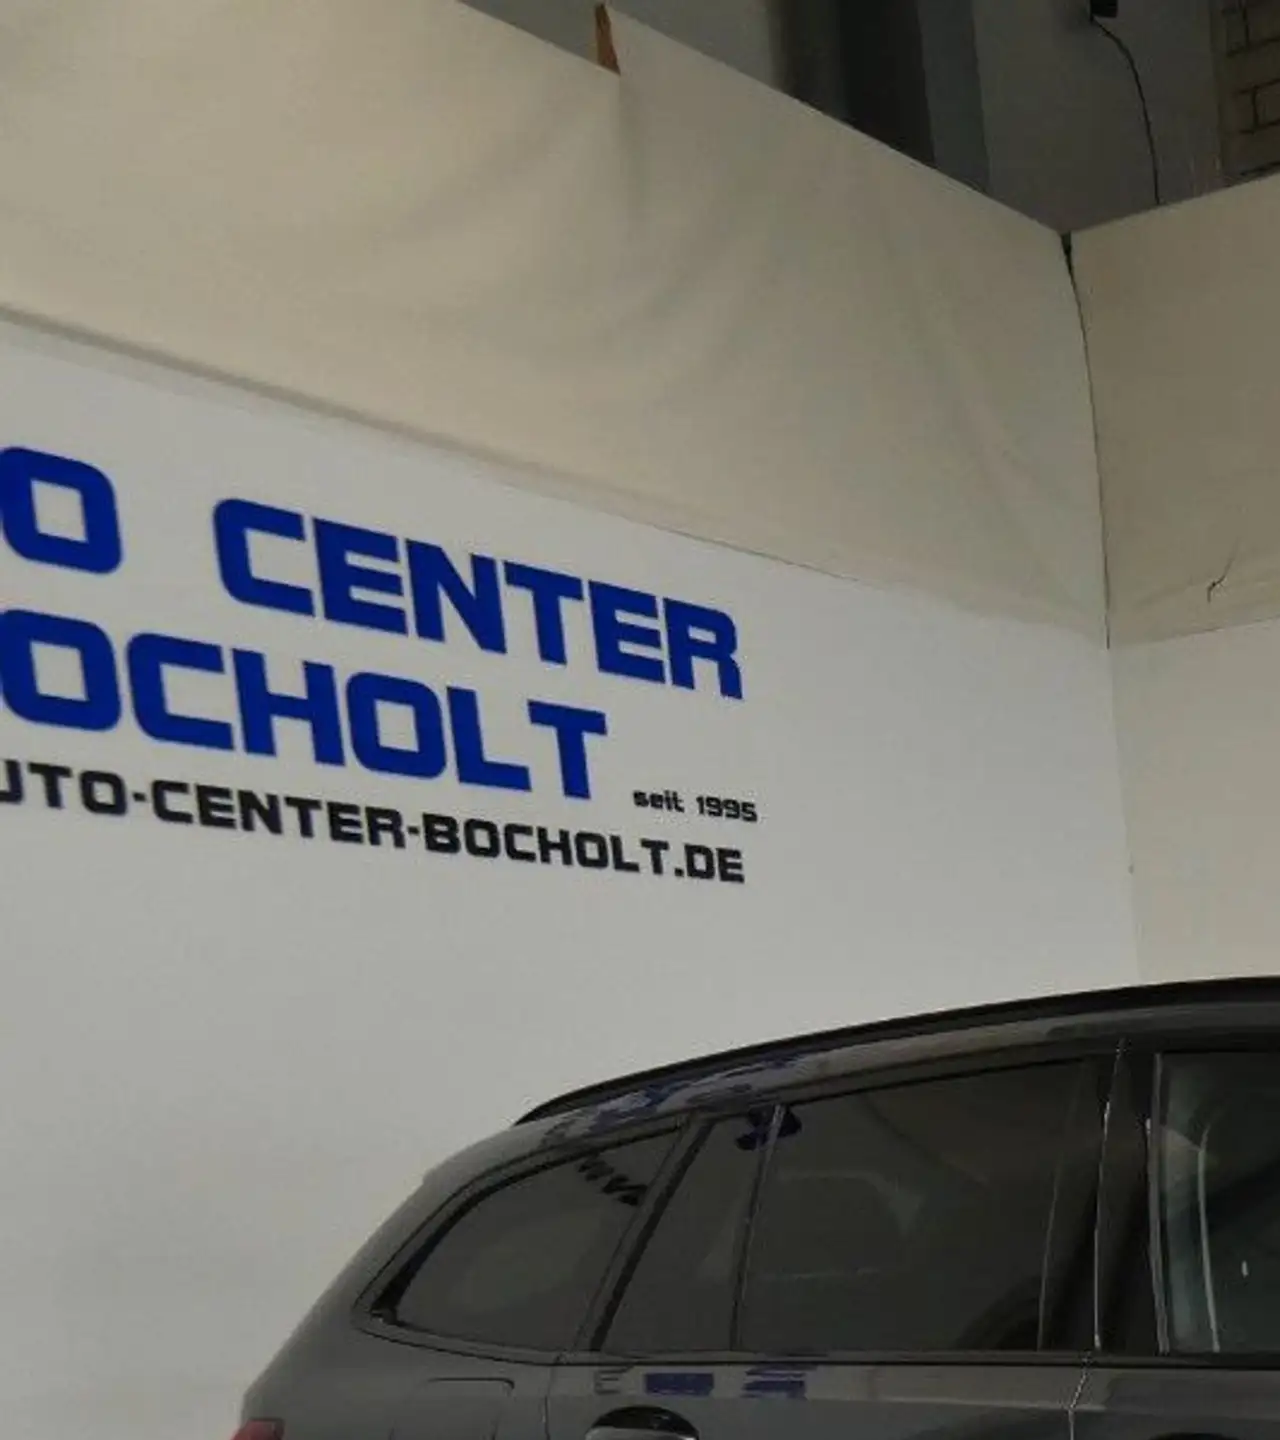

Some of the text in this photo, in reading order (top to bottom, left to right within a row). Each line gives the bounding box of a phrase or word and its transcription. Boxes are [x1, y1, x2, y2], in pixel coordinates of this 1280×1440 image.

[212, 498, 743, 699] CENTER
[0, 609, 607, 799] OCHOLT
[632, 790, 758, 823] seit 1995
